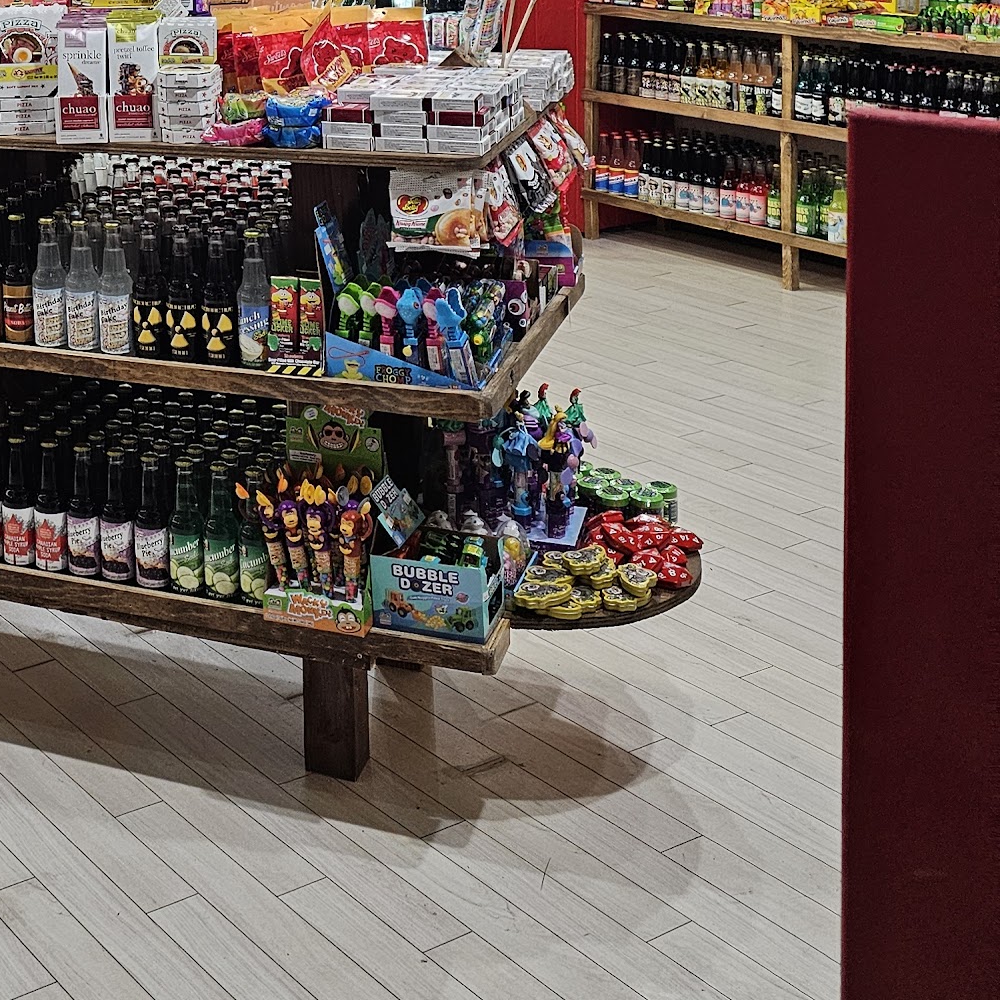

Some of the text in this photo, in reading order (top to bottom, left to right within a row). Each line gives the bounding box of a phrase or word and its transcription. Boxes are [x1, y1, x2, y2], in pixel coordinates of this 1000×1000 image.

[2, 18, 39, 28] Pizza
[173, 29, 199, 37] Pizza
[113, 46, 135, 54] pretzel
[62, 52, 102, 63] sprinkle
[62, 103, 97, 114] chuao
[115, 101, 150, 113] chuao
[36, 296, 64, 310] Birthday
[68, 298, 96, 312] Birthday
[37, 308, 53, 316] Cake
[100, 302, 128, 316] Birthday
[68, 311, 84, 320] Cake
[100, 314, 117, 323] Cake
[375, 365, 411, 377] FROGGY
[375, 373, 411, 385] CHOMP
[372, 477, 395, 503] BUBBLE
[391, 564, 459, 585] BUBBLE
